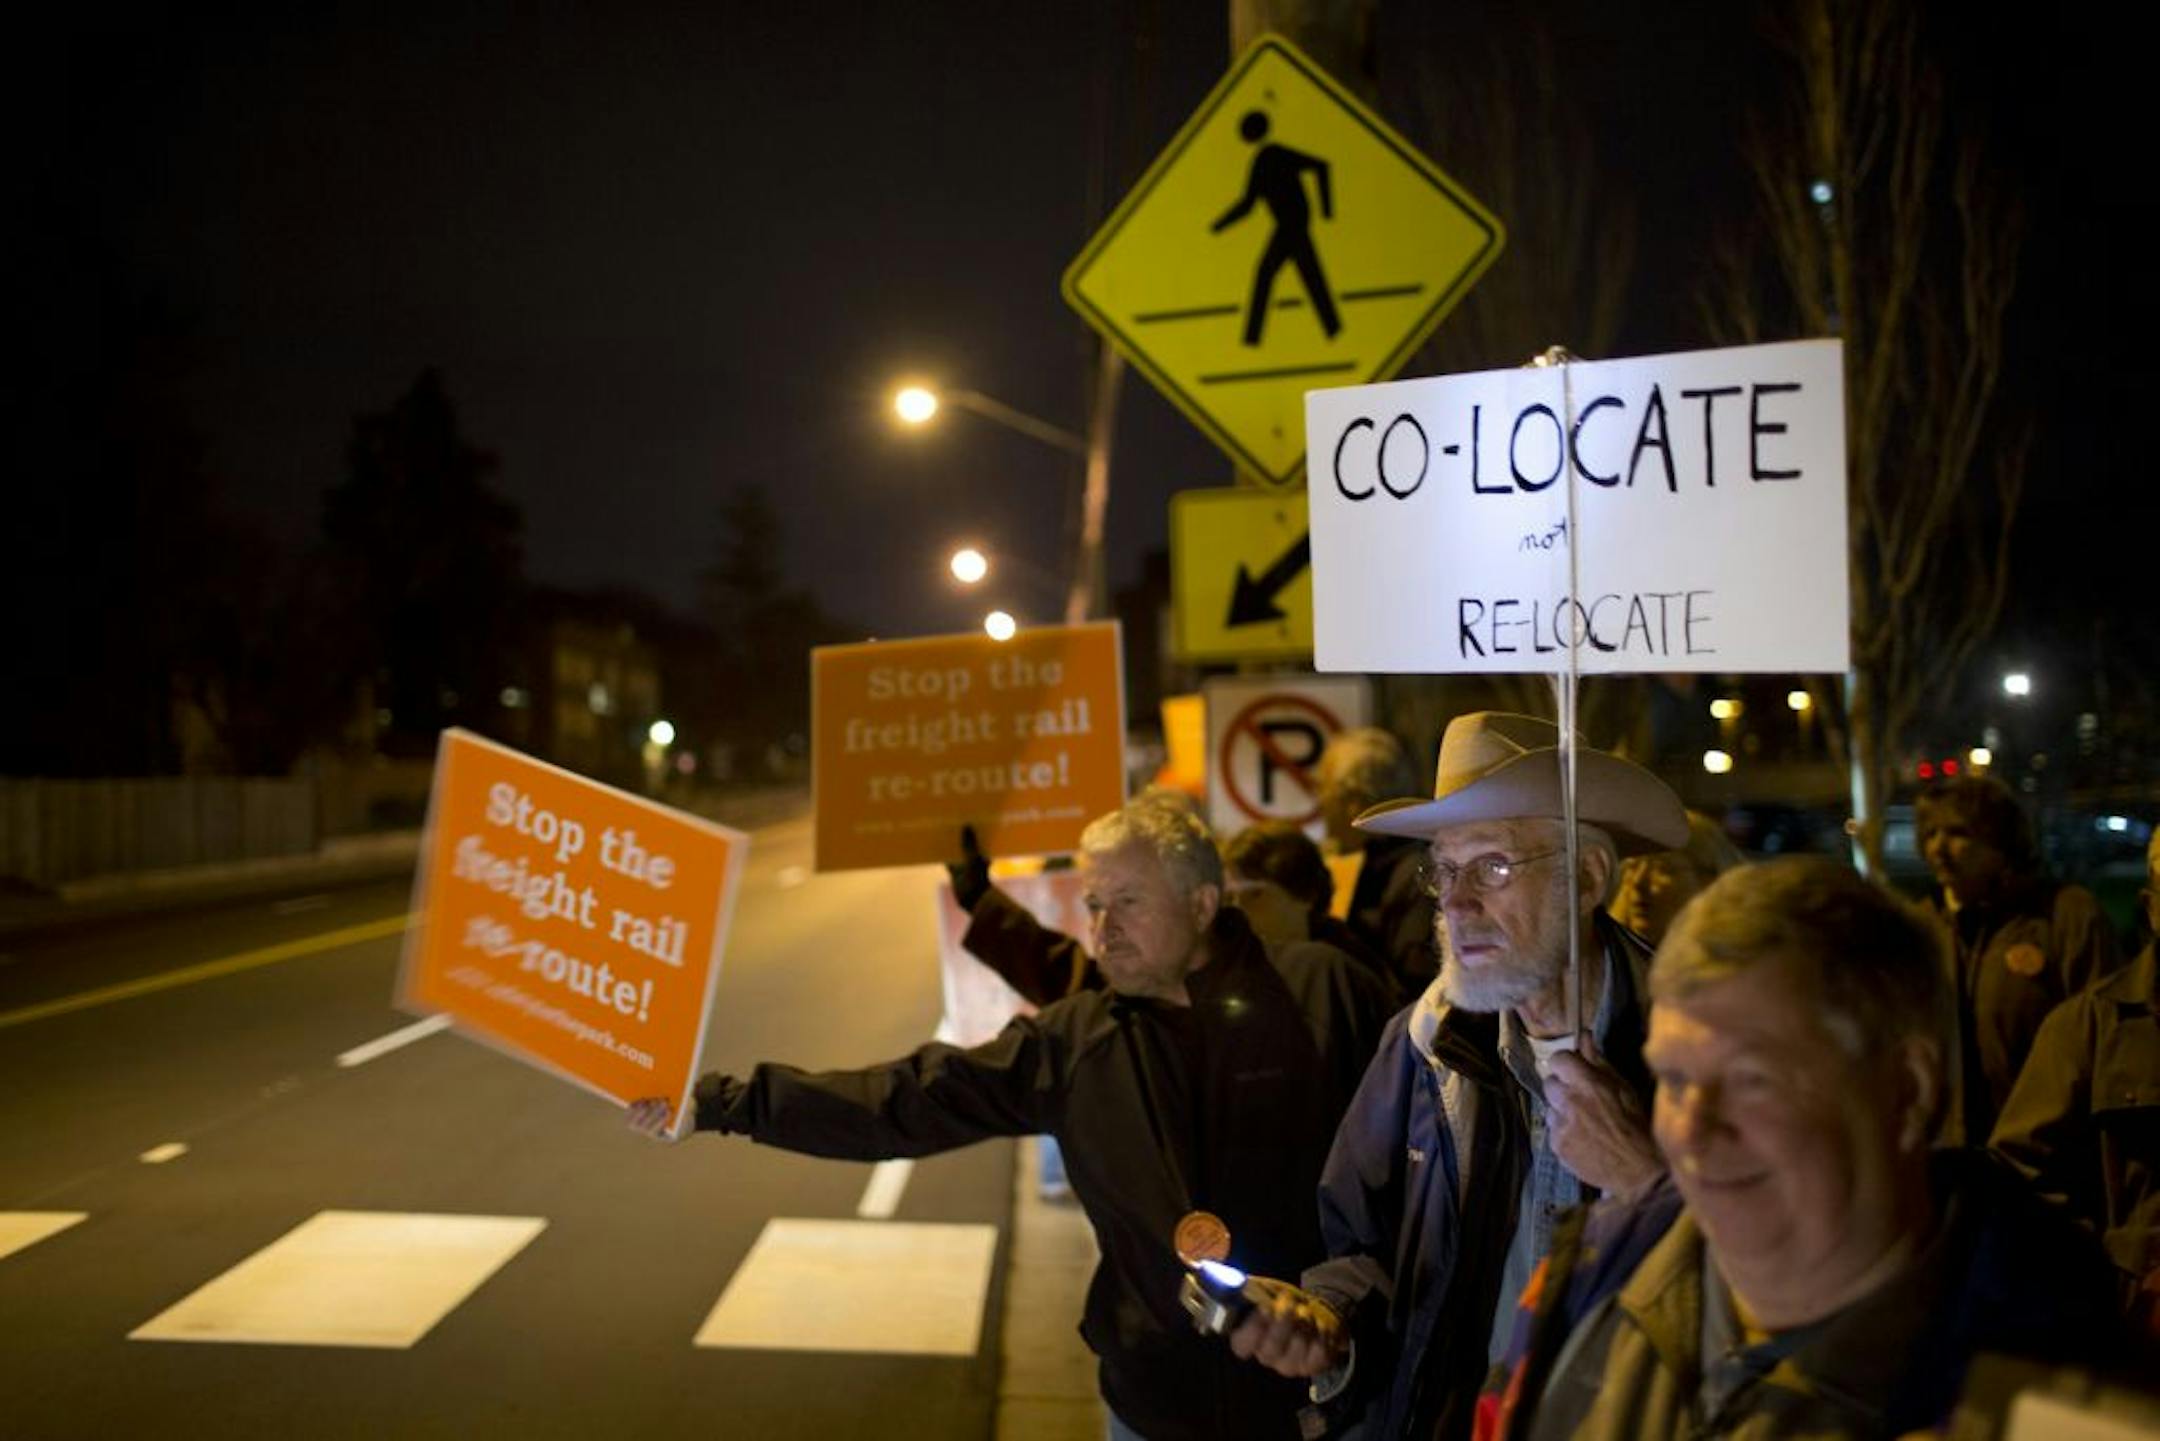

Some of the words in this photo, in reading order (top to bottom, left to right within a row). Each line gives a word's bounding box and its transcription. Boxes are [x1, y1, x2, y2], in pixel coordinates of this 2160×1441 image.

[1333, 382, 1803, 501] CO-LOCATE
[1518, 515, 1567, 552] not
[1458, 590, 1715, 658] RE-LOCATE
[867, 665, 970, 703] Stop
[989, 653, 1064, 690] the
[844, 710, 996, 753] freight
[1014, 697, 1092, 740] rail
[866, 751, 1071, 801] re-route!
[487, 781, 585, 862] Stop
[599, 825, 676, 888] the
[607, 908, 689, 968] rail
